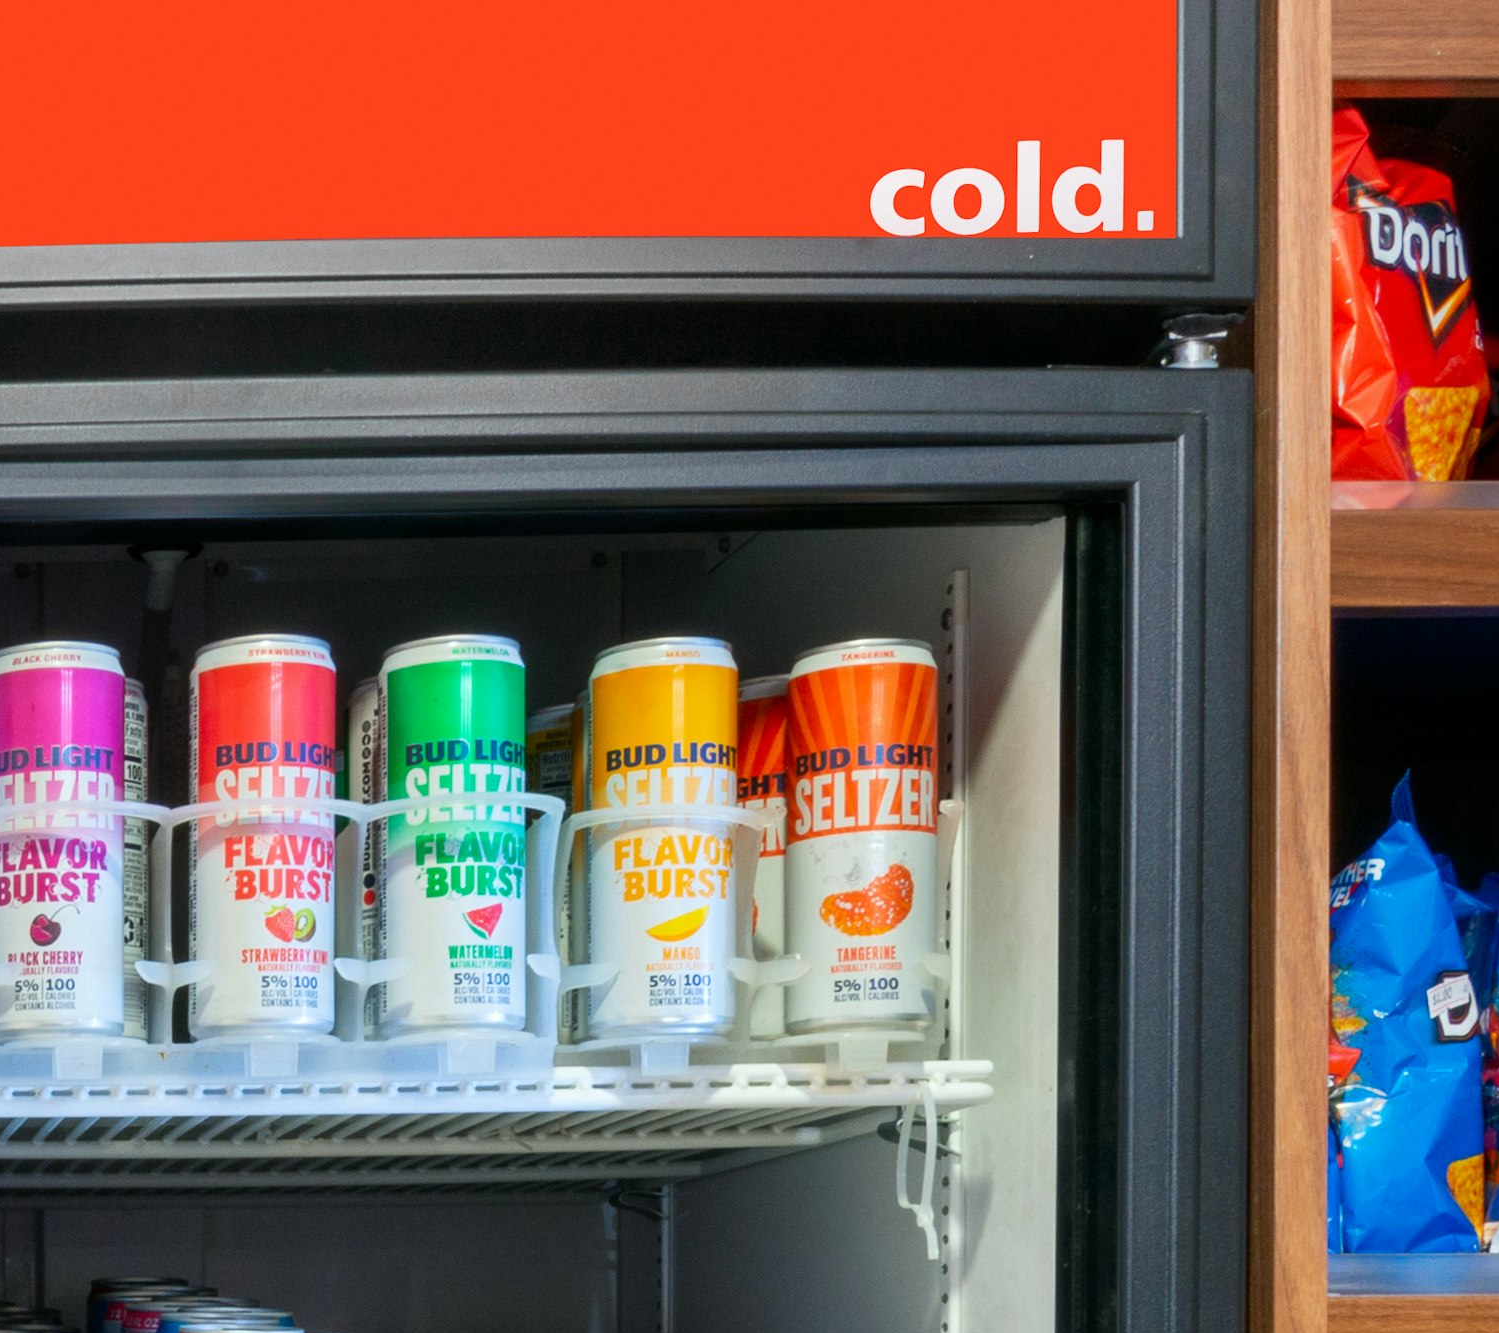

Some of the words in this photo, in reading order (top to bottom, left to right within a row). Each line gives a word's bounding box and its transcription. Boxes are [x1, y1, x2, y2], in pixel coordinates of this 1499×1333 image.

[870, 139, 1154, 236] cold.
[35, 745, 114, 769] LIGHT
[796, 752, 850, 773] BUD
[858, 744, 933, 770] LIGHT
[795, 770, 934, 834] SELTZER
[836, 946, 895, 961] TANGERINE
